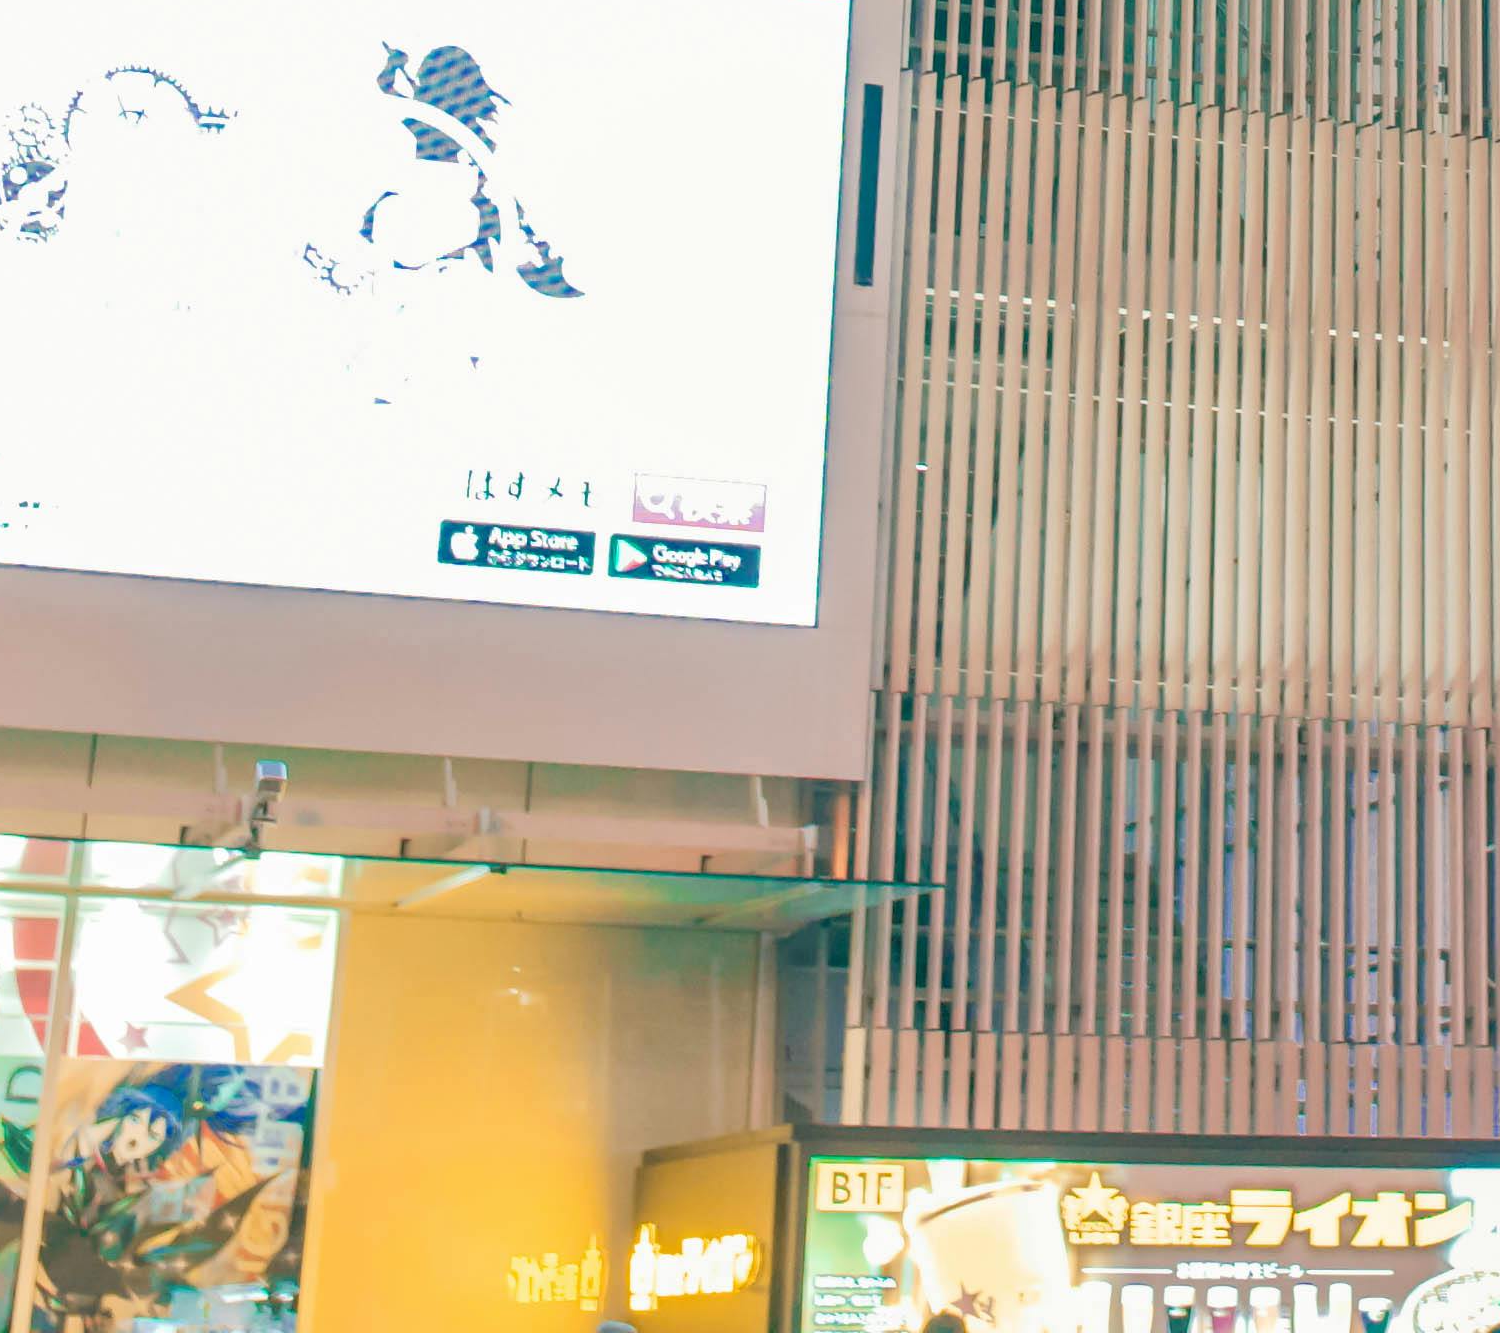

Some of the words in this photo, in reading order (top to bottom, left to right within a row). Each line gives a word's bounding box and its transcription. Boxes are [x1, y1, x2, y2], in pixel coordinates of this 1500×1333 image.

[487, 526, 529, 552] App
[651, 543, 708, 567] Google
[831, 1171, 894, 1205] B1F
[1129, 1187, 1474, 1248] 銀座ライオン
